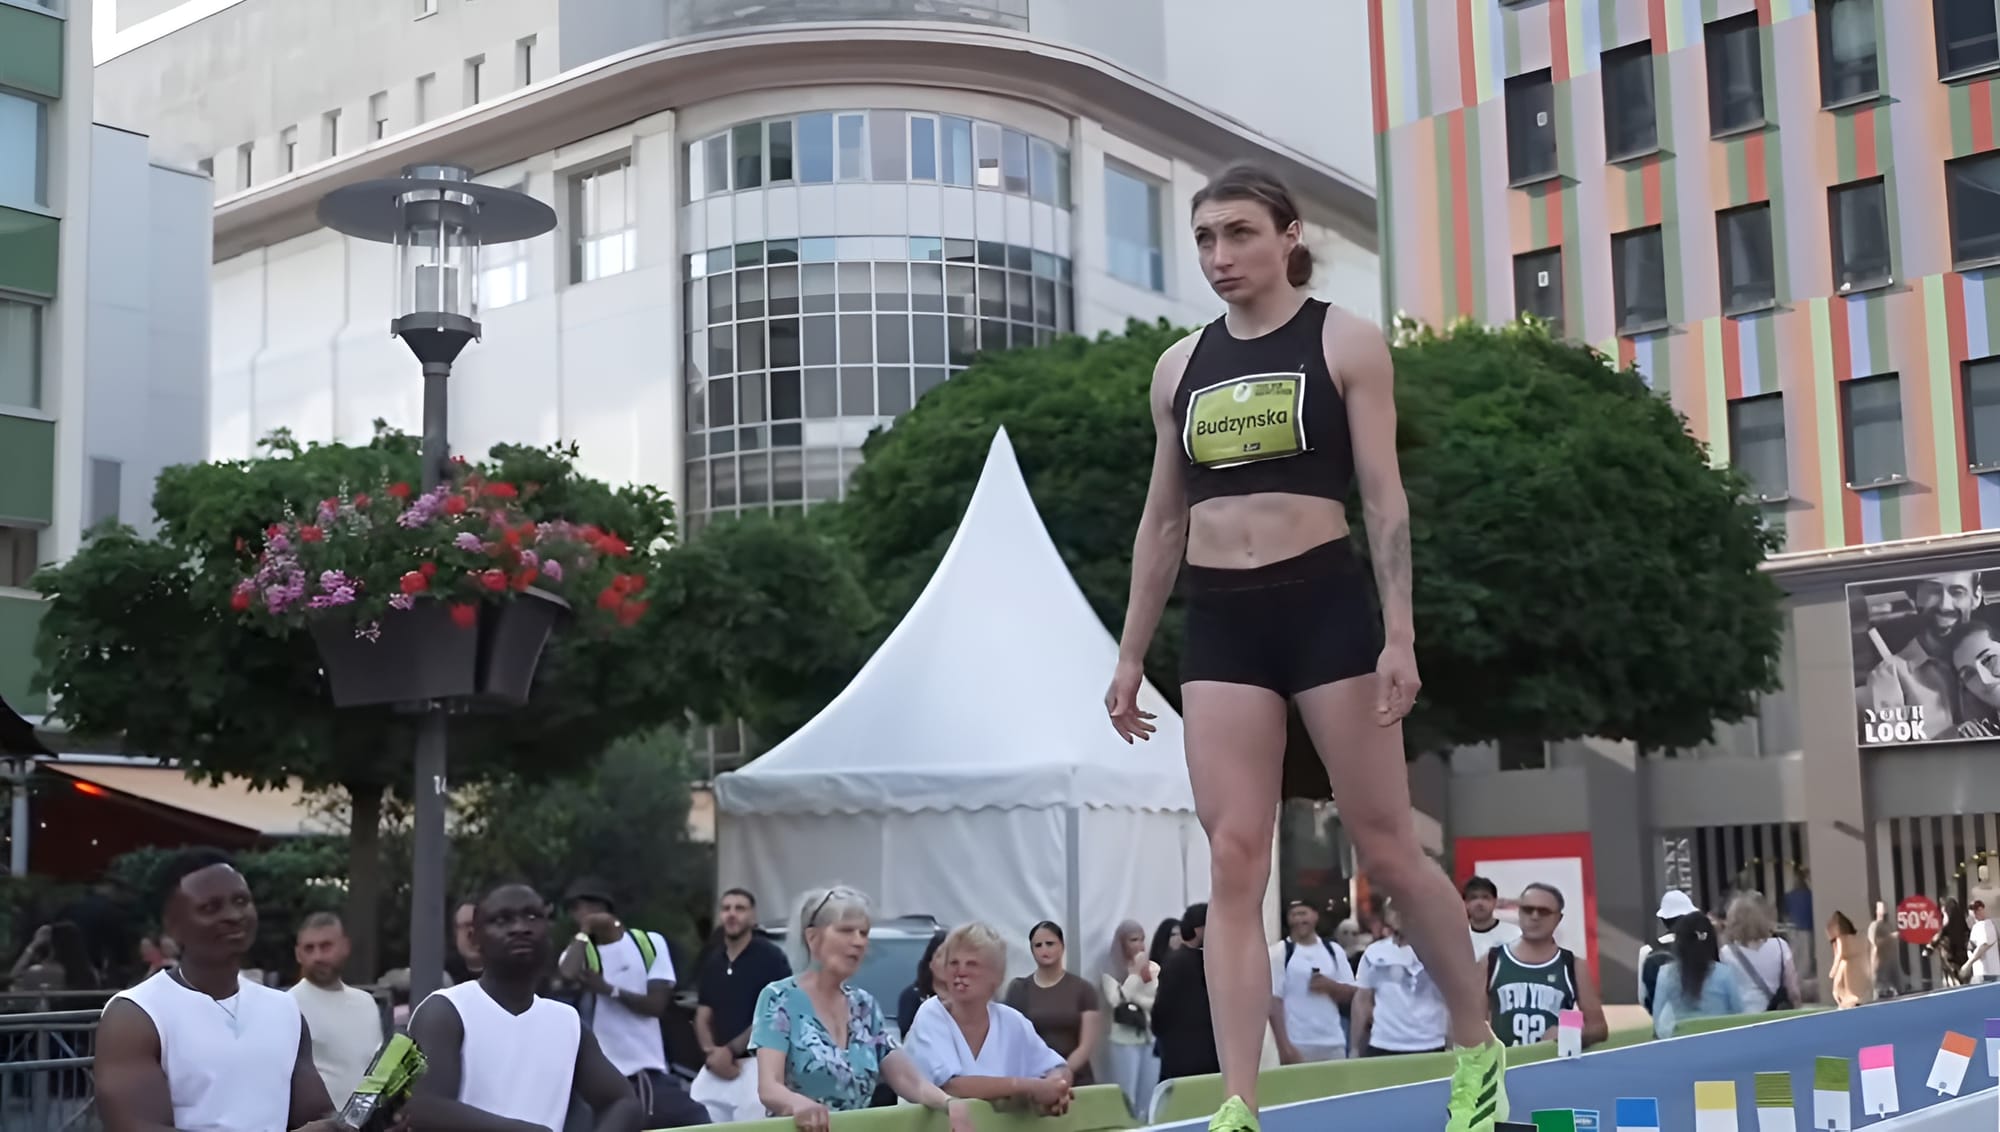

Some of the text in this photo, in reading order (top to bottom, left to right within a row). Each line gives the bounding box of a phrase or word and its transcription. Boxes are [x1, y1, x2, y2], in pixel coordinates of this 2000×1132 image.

[1197, 408, 1287, 436] Budzynska
[1864, 720, 1928, 743] LOOK
[1897, 910, 1939, 929] 50%
